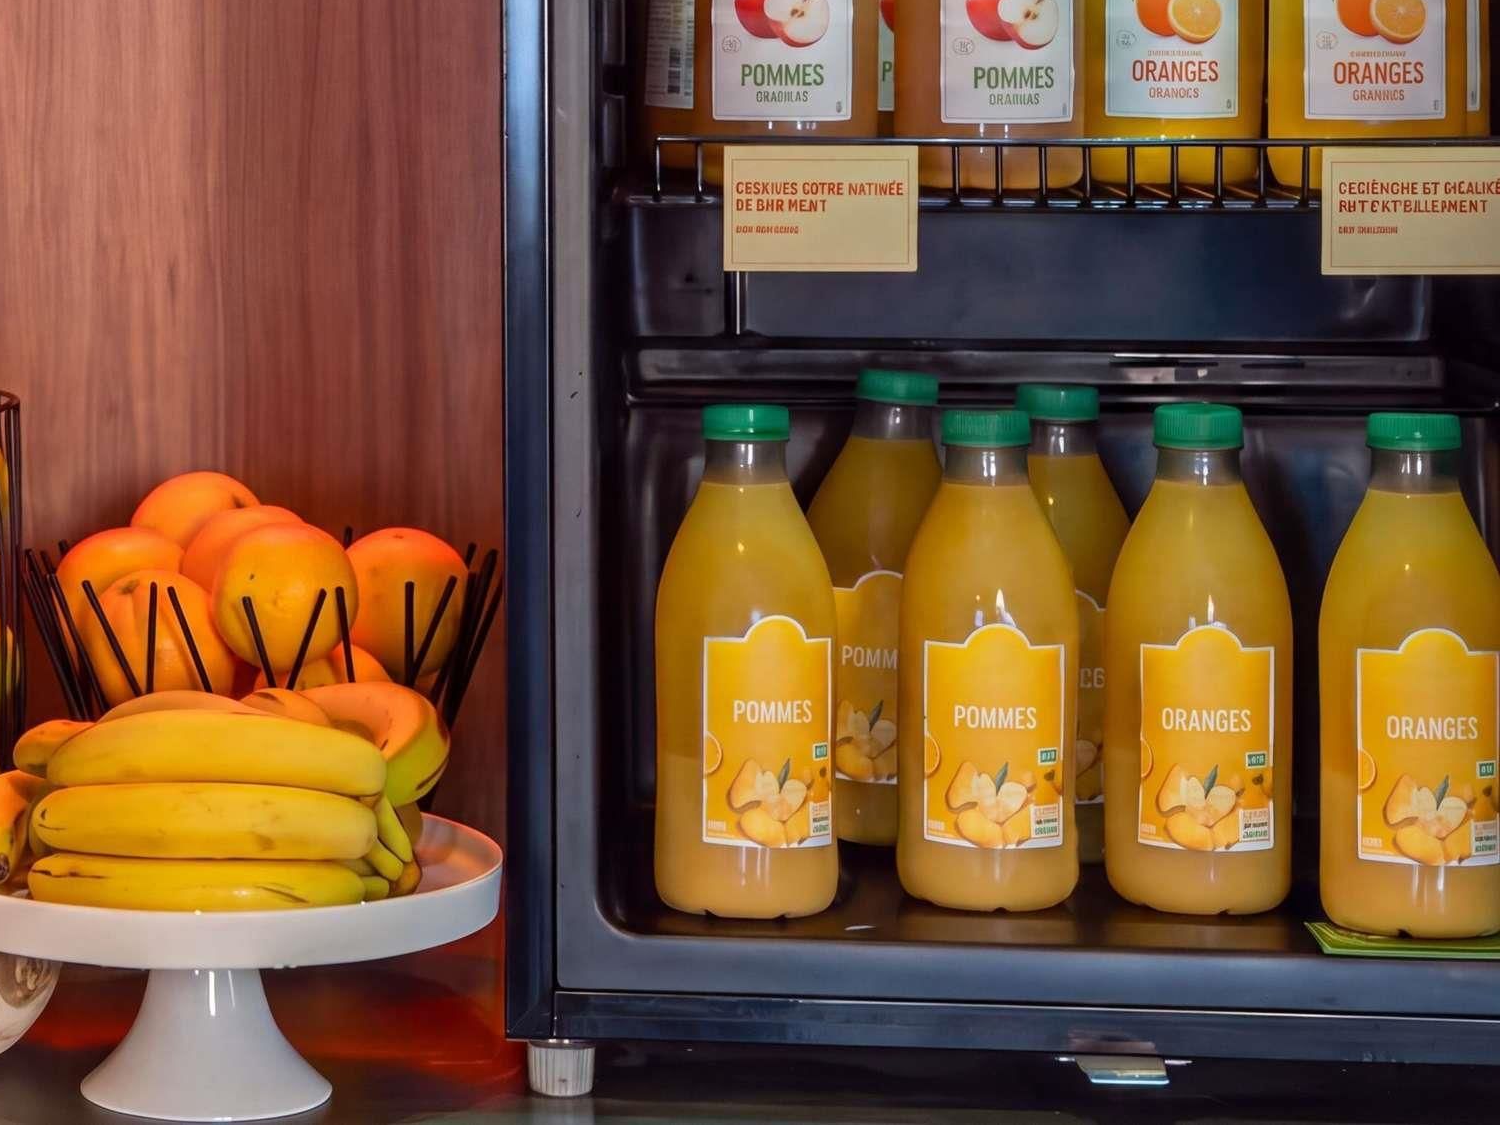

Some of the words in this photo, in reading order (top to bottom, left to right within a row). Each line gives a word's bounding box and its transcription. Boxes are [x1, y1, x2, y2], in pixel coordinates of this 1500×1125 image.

[741, 64, 825, 87] POMMES
[973, 66, 1054, 89] POMMES
[1132, 60, 1219, 82] ORANGES
[1334, 62, 1424, 84] ORANGES
[736, 198, 753, 212] DE
[733, 699, 813, 724] POMMES
[954, 704, 1037, 730] POMMES
[1162, 708, 1252, 733] ORANGES
[1386, 715, 1479, 740] ORANGES
